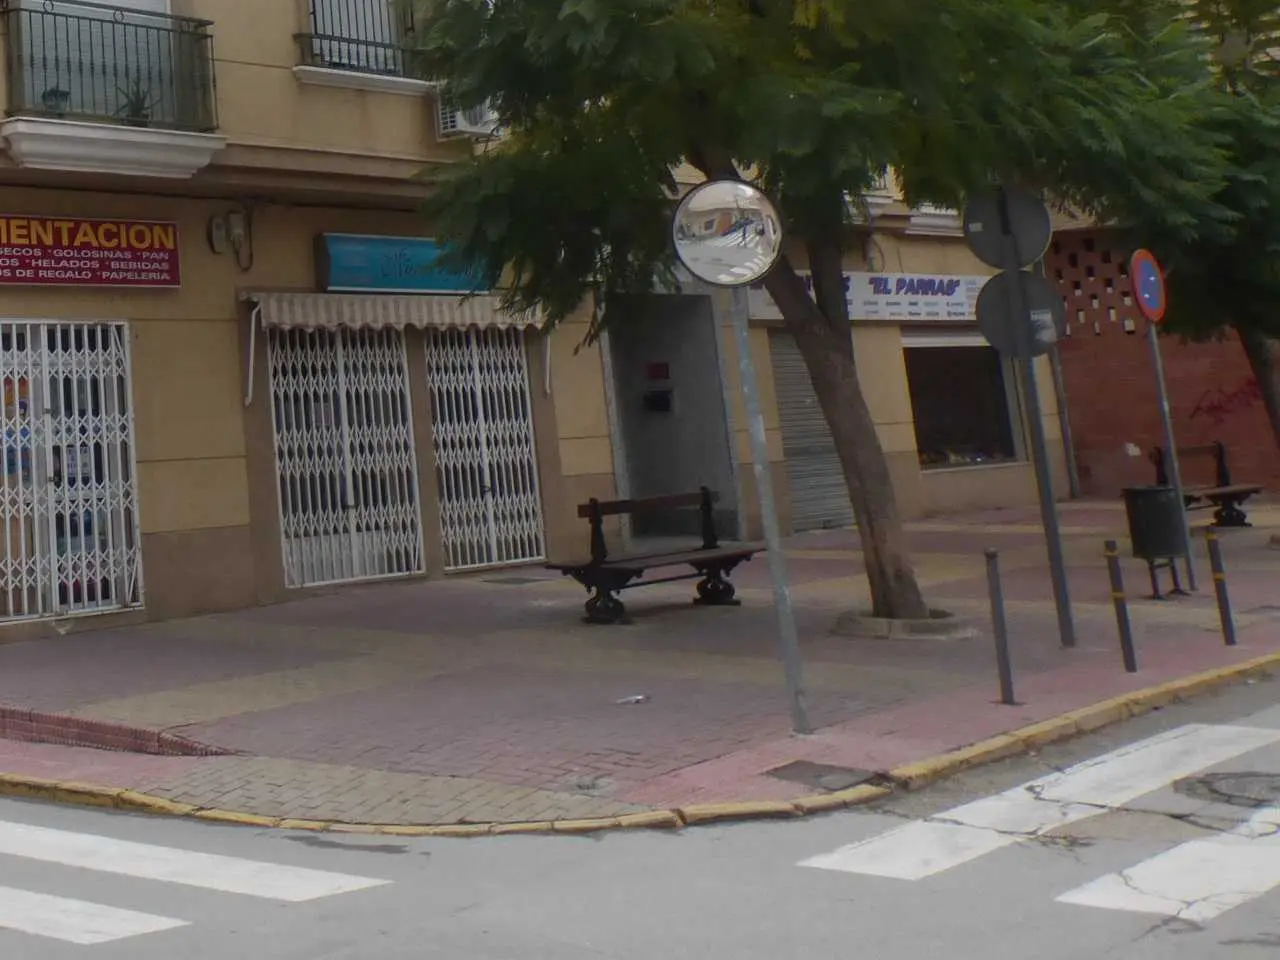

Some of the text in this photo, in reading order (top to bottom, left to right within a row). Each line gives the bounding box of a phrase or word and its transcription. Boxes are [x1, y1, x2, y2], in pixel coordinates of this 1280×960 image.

[53, 249, 132, 259] GOLOSINAS
[142, 252, 169, 260] PAN
[31, 258, 100, 269] HELADOS
[111, 261, 169, 270] BEBIDAS
[16, 269, 35, 278] DE
[39, 269, 92, 279] REGALO
